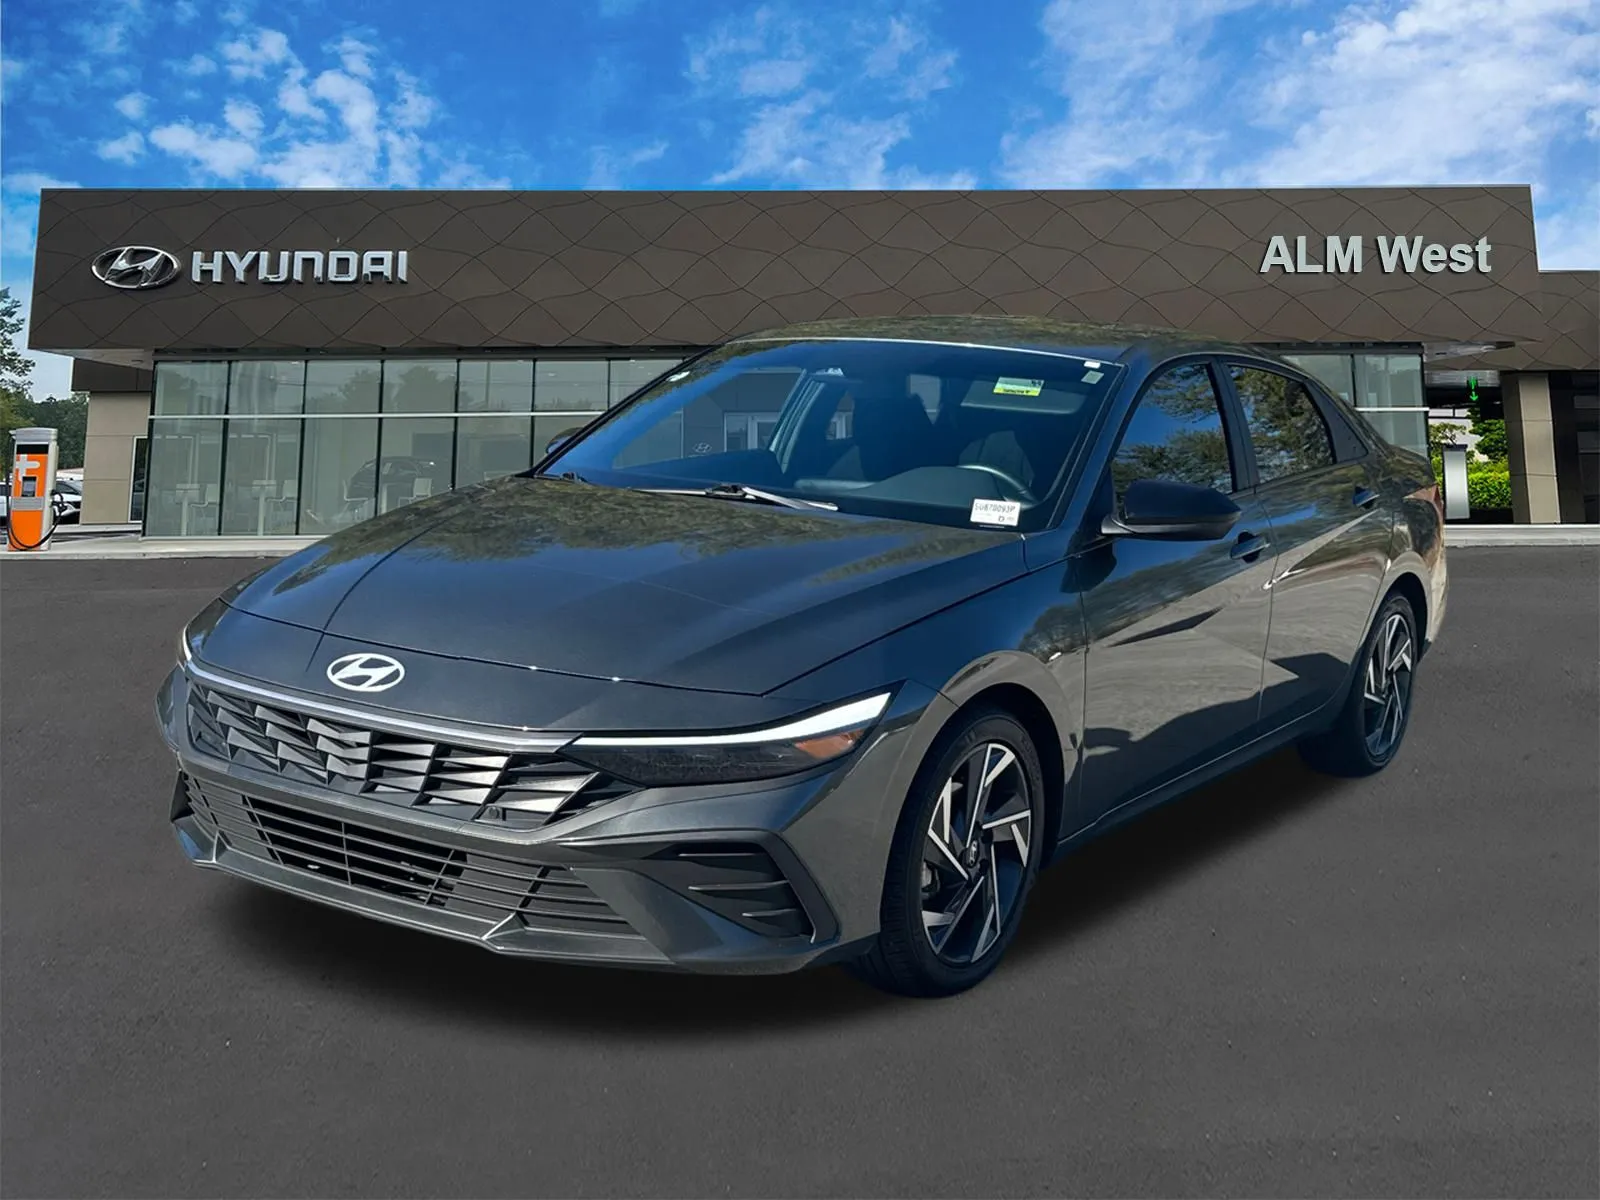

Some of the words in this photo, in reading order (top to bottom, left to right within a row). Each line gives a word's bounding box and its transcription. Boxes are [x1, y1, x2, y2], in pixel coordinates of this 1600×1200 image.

[191, 250, 408, 283] HYUNDAI
[1260, 235, 1363, 273] ALM
[1377, 235, 1492, 273] West
